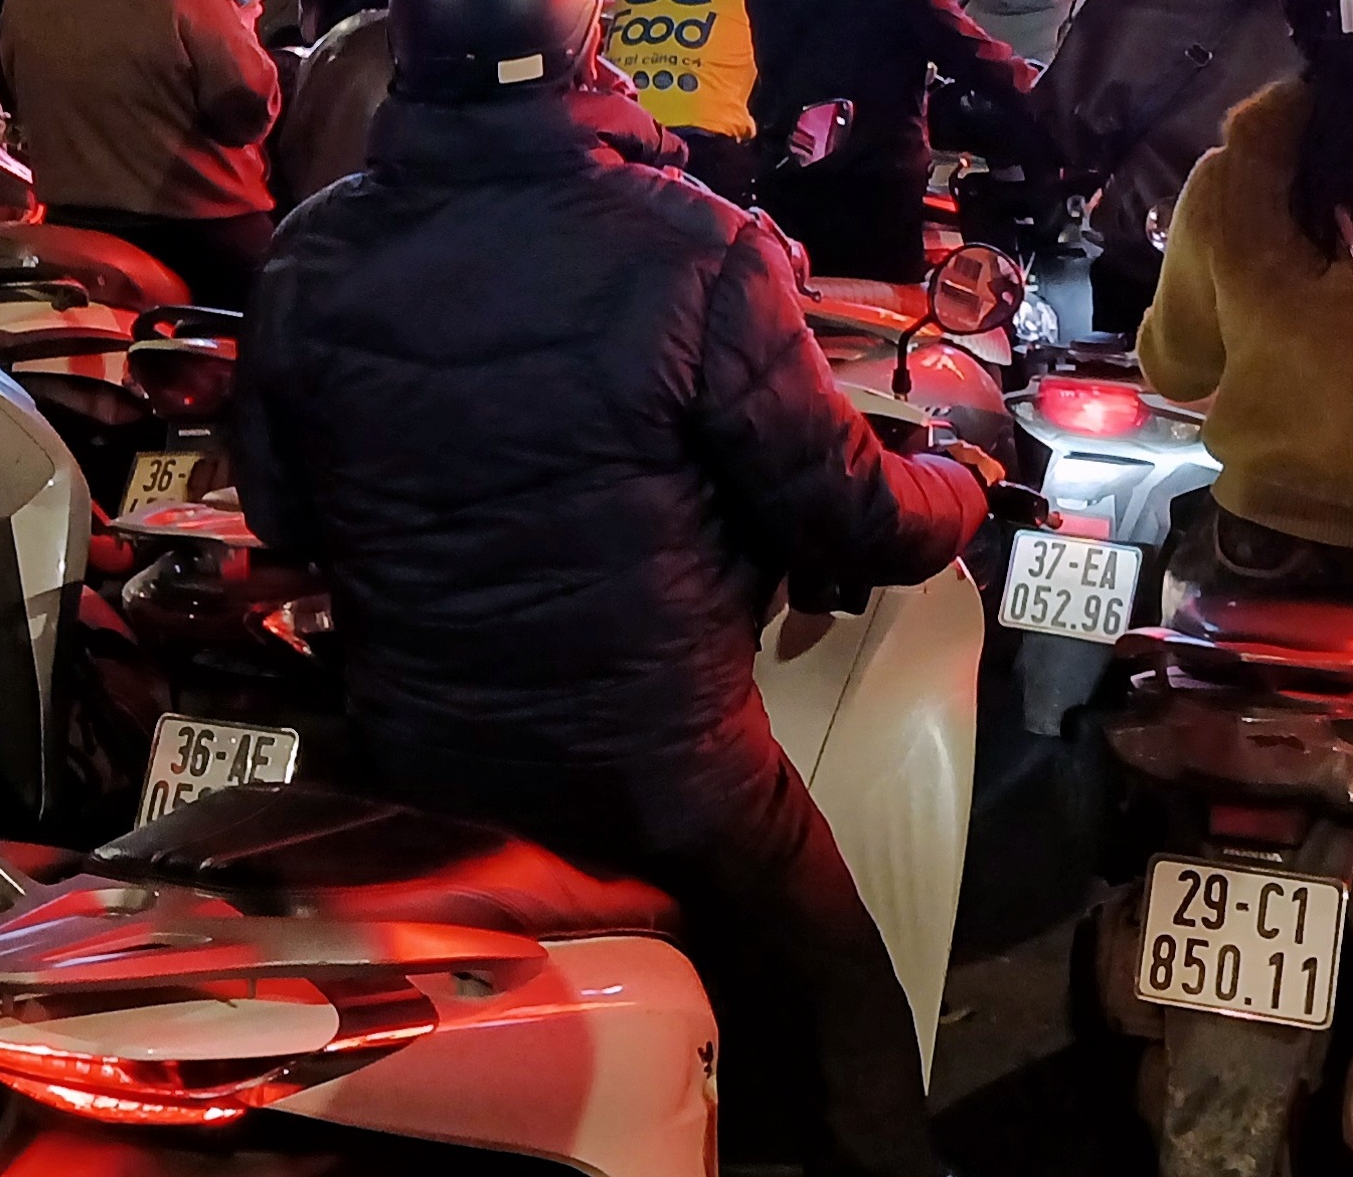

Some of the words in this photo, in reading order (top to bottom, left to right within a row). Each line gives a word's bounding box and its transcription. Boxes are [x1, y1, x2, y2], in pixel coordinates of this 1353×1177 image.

[1027, 540, 1119, 591] 37-EA
[1010, 584, 1125, 637] 052.96
[1172, 868, 1310, 945] 29-C1
[1149, 933, 1320, 1017] 850.11
